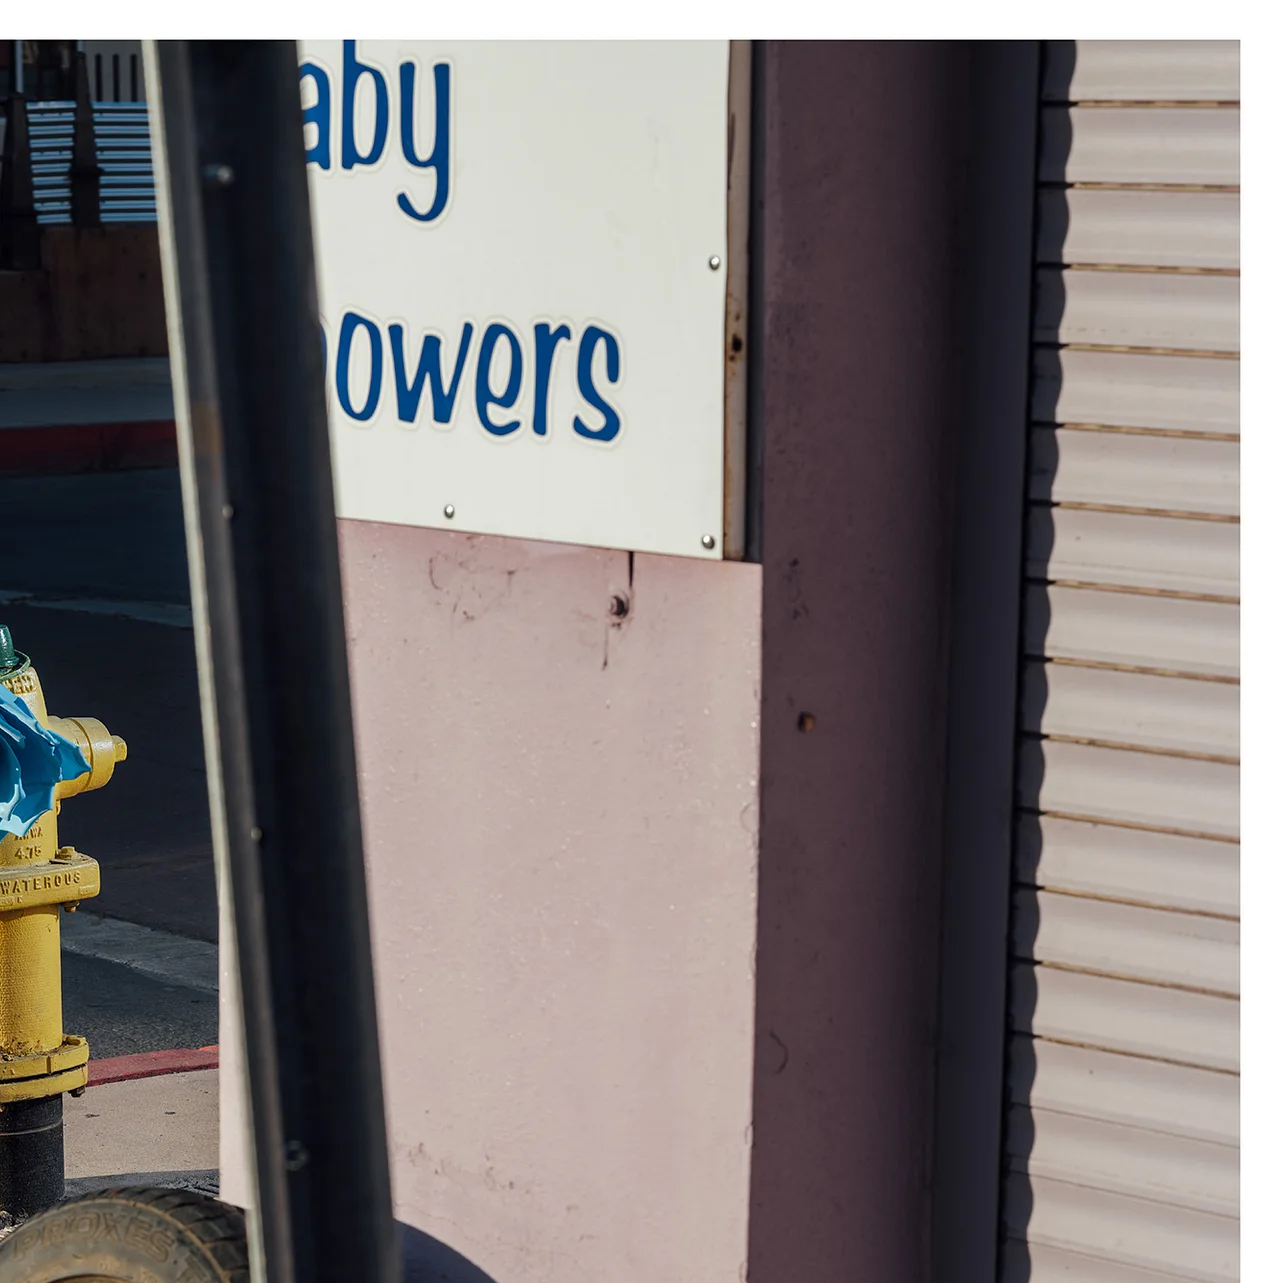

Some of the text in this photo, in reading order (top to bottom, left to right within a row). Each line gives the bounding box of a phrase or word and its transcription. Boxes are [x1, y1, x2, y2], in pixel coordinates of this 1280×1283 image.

[320, 311, 621, 442] owers
[0, 870, 81, 895] WATEROUS
[12, 1209, 175, 1263] PROXES
